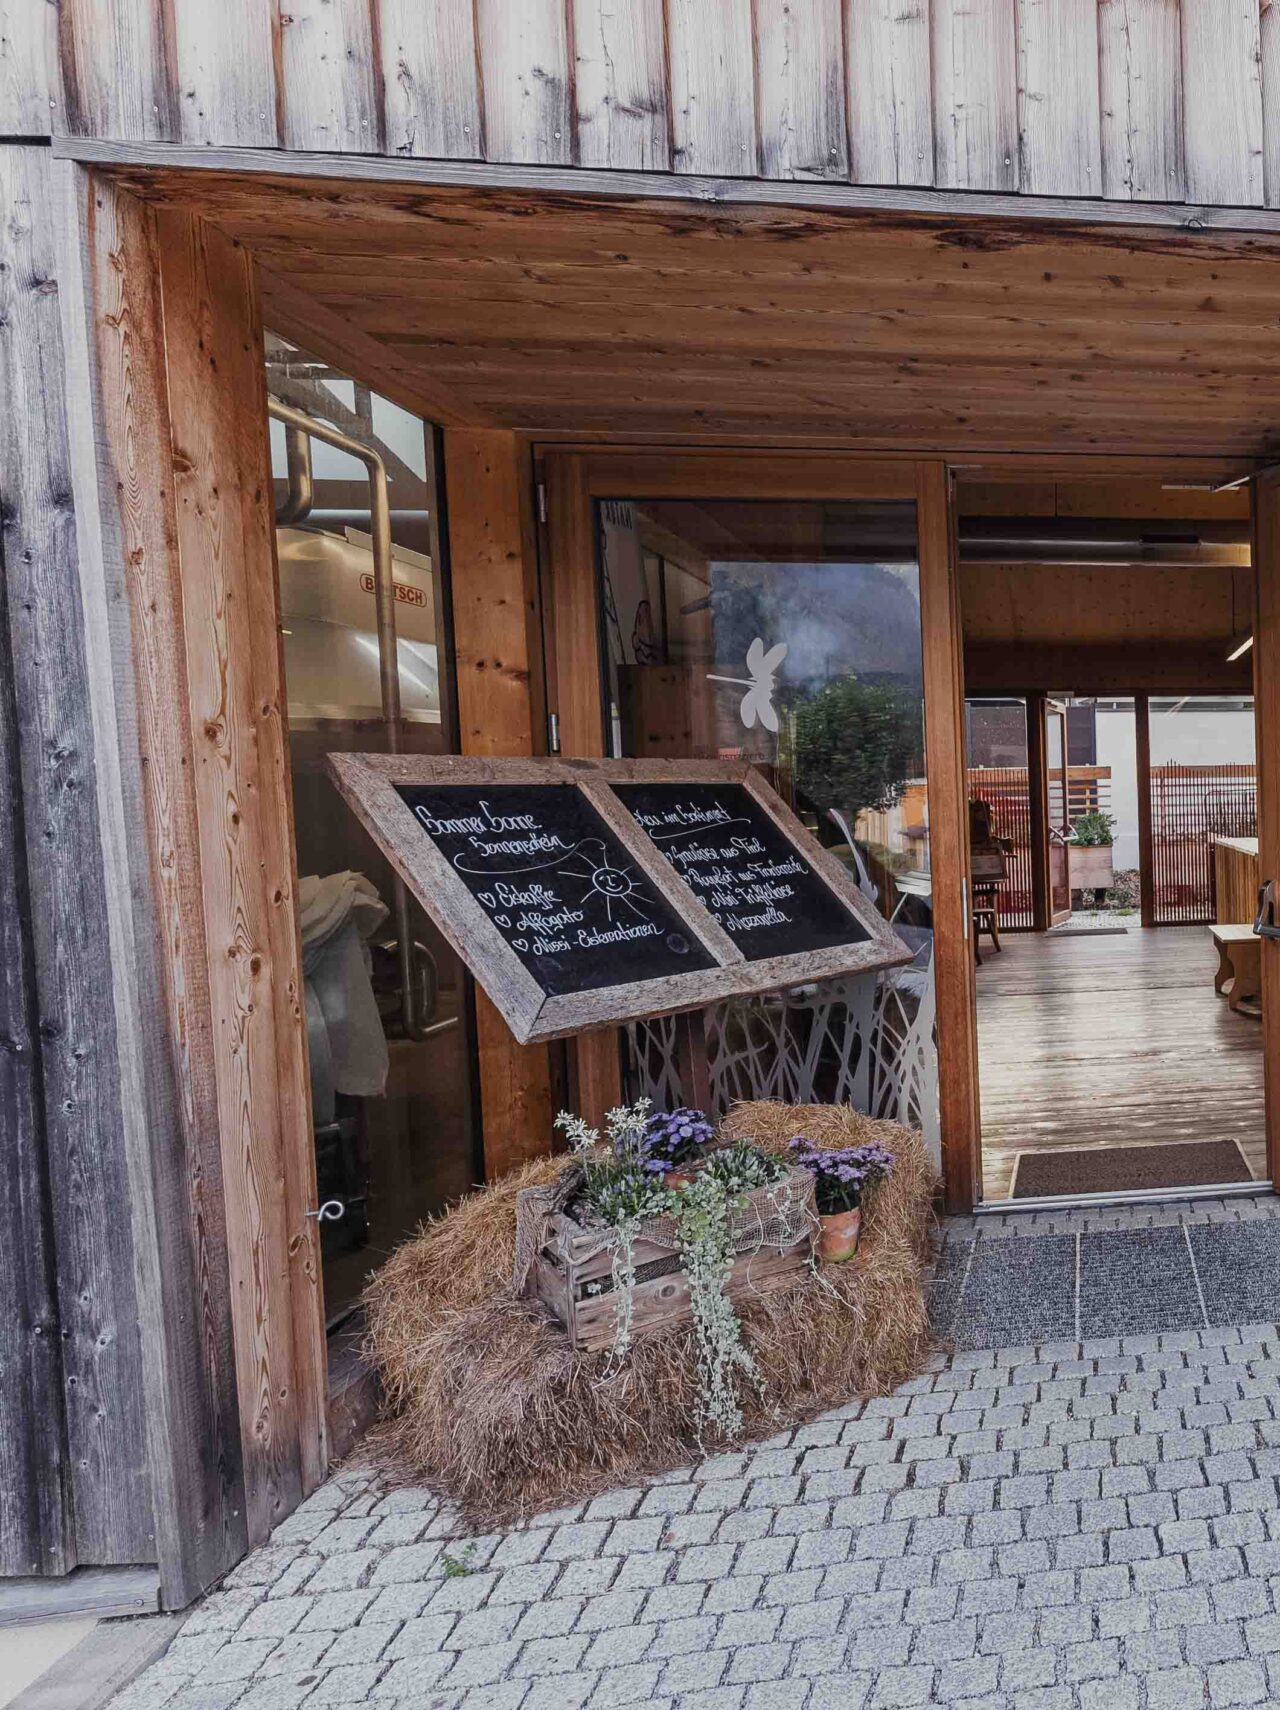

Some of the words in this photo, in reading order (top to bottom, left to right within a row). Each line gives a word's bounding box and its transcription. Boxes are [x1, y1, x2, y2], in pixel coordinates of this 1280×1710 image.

[365, 577, 422, 604] BTSCH
[415, 806, 487, 835] Sommer
[479, 801, 542, 832] Sonne
[662, 811, 688, 825] im
[468, 833, 575, 856] Sonnenschein
[720, 846, 740, 859] aus
[730, 837, 766, 855] Tirol
[738, 871, 757, 881] aus
[517, 906, 583, 935] Affogato
[727, 907, 792, 931] Mozzarella
